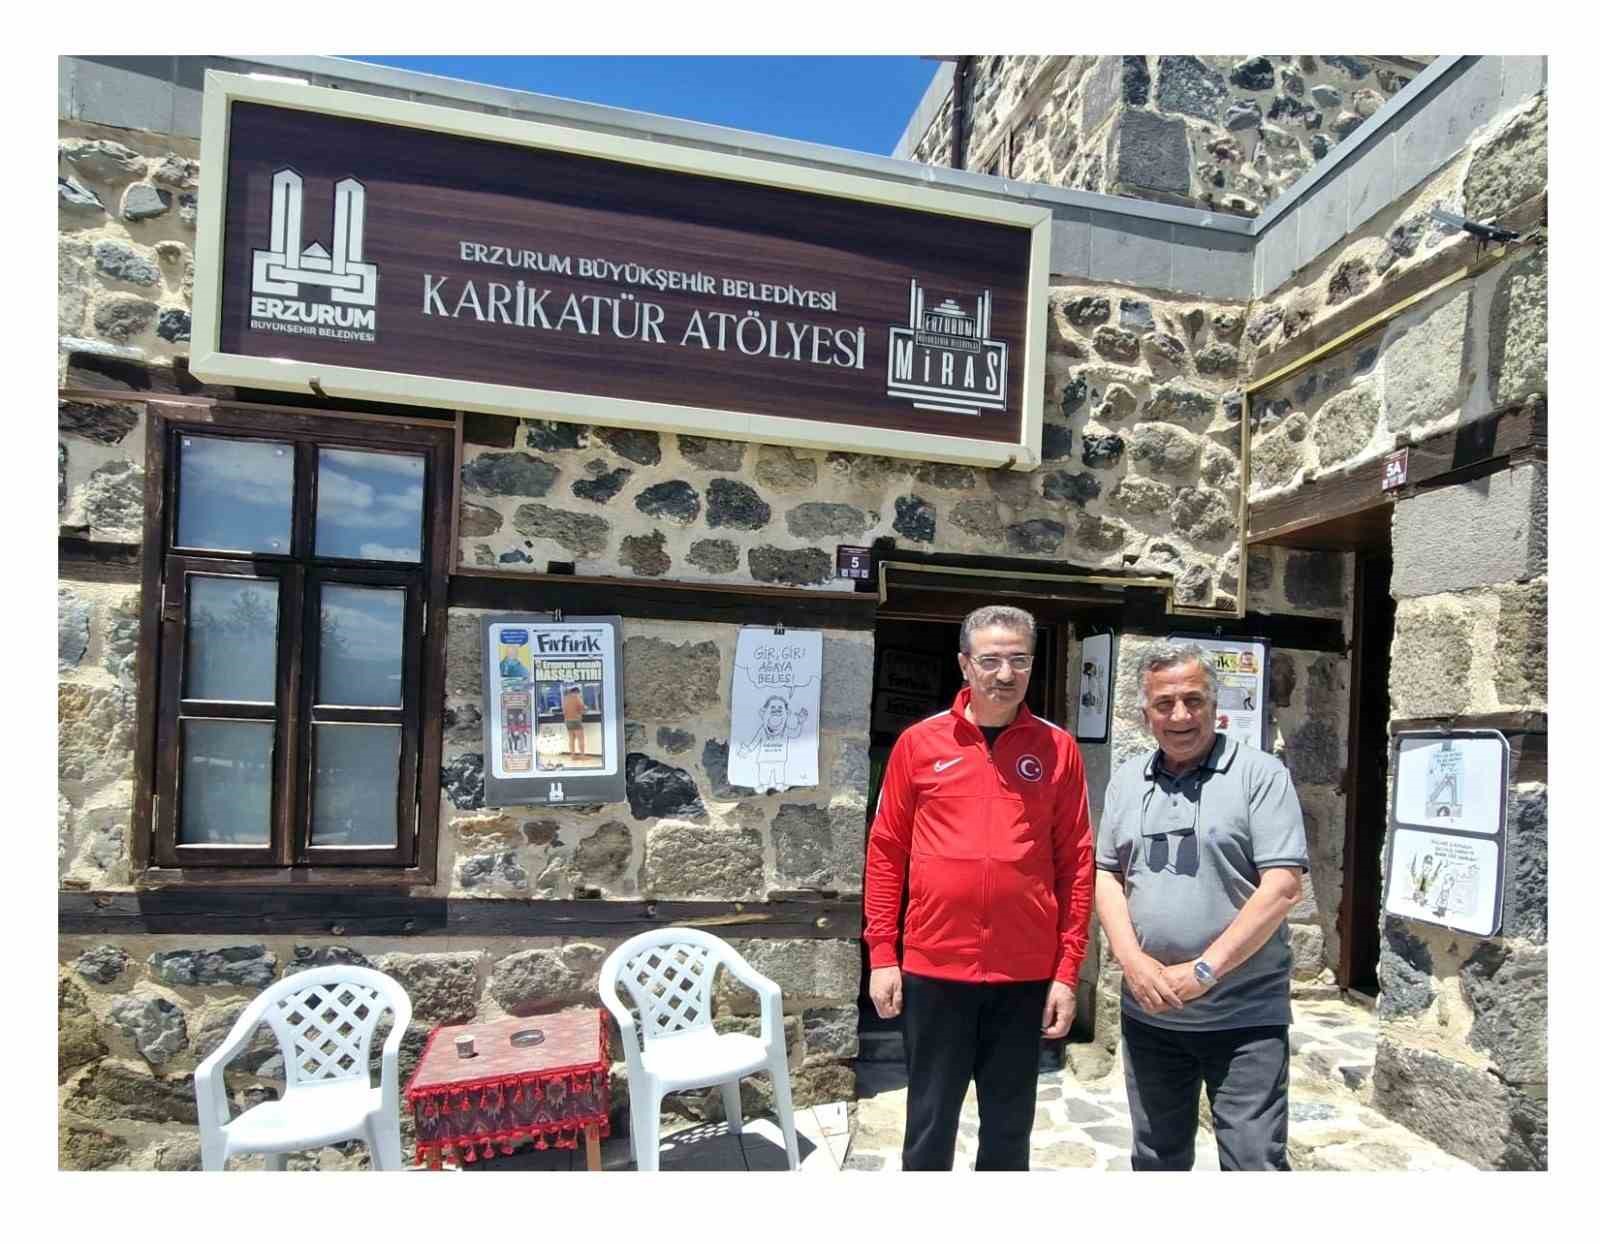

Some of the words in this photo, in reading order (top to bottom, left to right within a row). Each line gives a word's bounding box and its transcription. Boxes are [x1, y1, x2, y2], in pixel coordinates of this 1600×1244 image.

[460, 241, 572, 275] ERZURUM
[578, 258, 716, 294] BÜYÜKŞEHİR
[722, 278, 838, 311] BELEDİYESİ
[251, 296, 375, 330] ERZURUM
[423, 274, 666, 344] KARİKATÜR
[680, 309, 865, 369] ATÖLYESİ
[1386, 461, 1402, 477] 5A
[851, 556, 860, 569] 5
